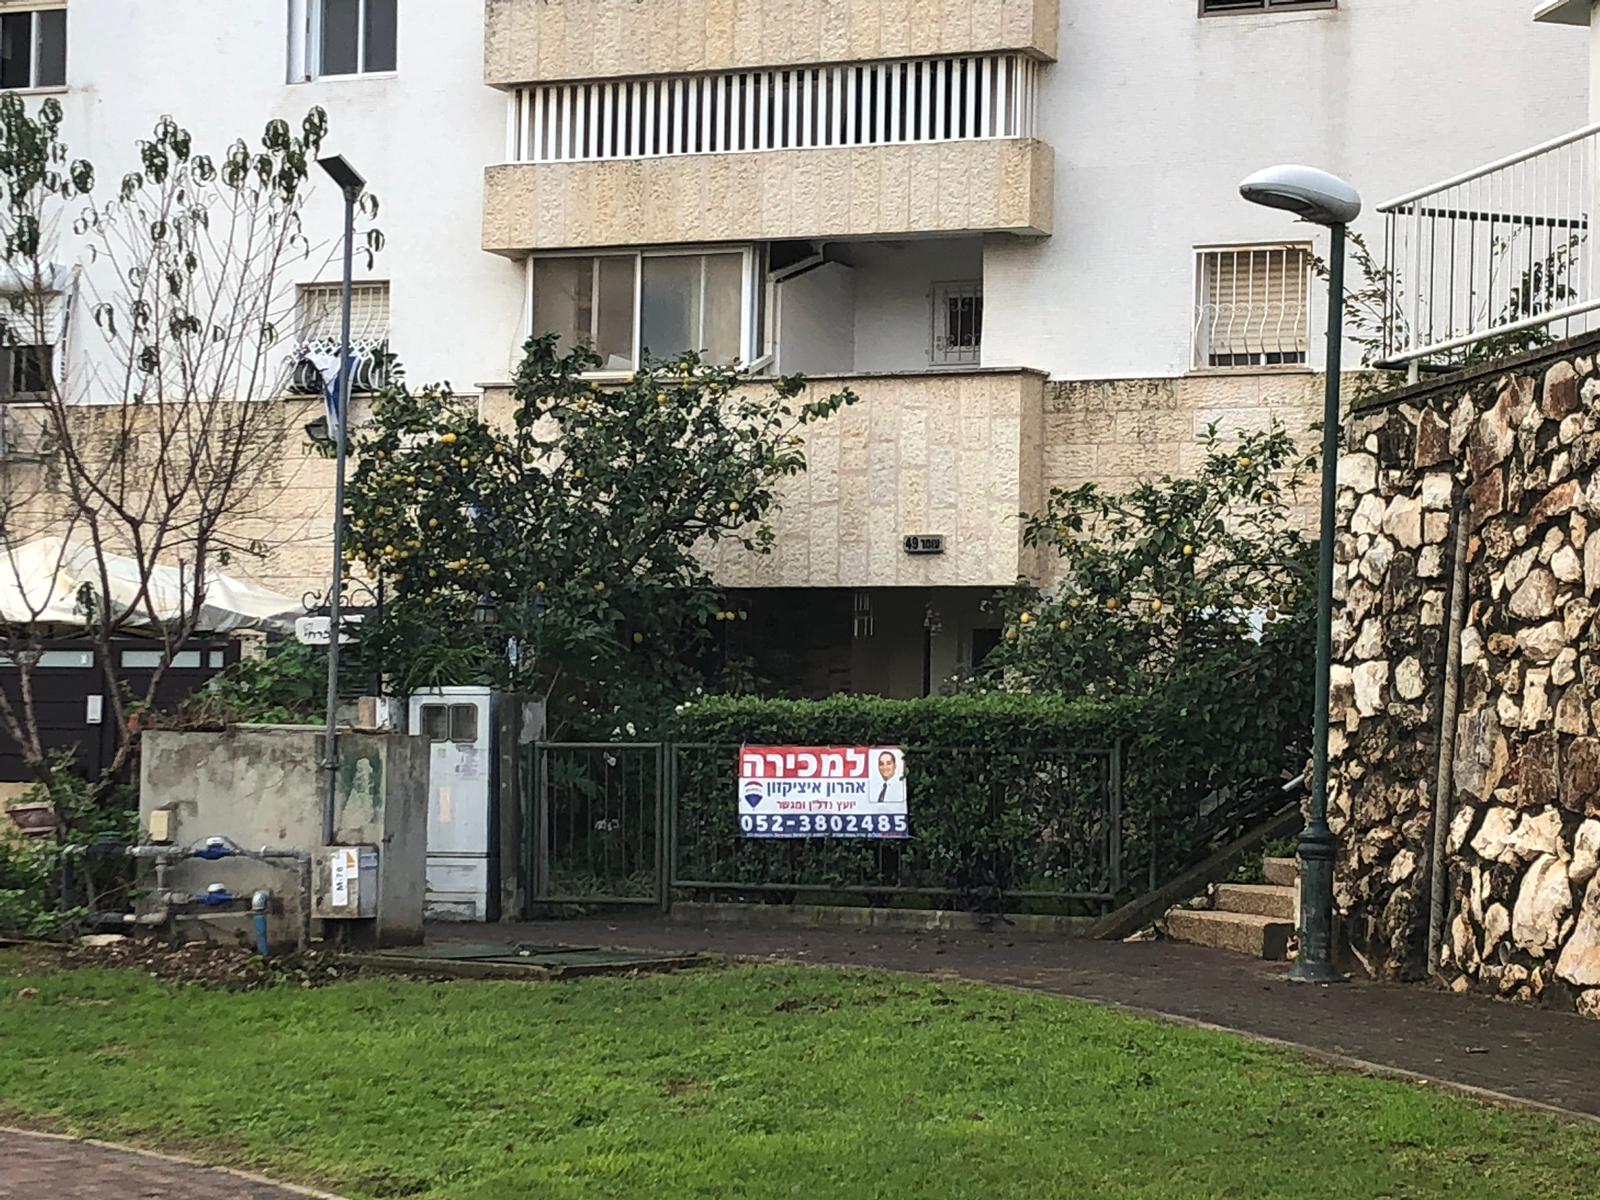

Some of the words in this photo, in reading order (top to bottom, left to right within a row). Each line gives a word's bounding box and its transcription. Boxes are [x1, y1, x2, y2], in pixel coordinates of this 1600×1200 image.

[905, 536, 919, 550] 49
[743, 749, 866, 777] למכירה
[767, 782, 821, 797] איציקזון
[826, 782, 865, 797] אהרון
[776, 801, 806, 810] ומגשר
[836, 801, 856, 811] יועץ
[741, 815, 907, 832] 052-3802485
